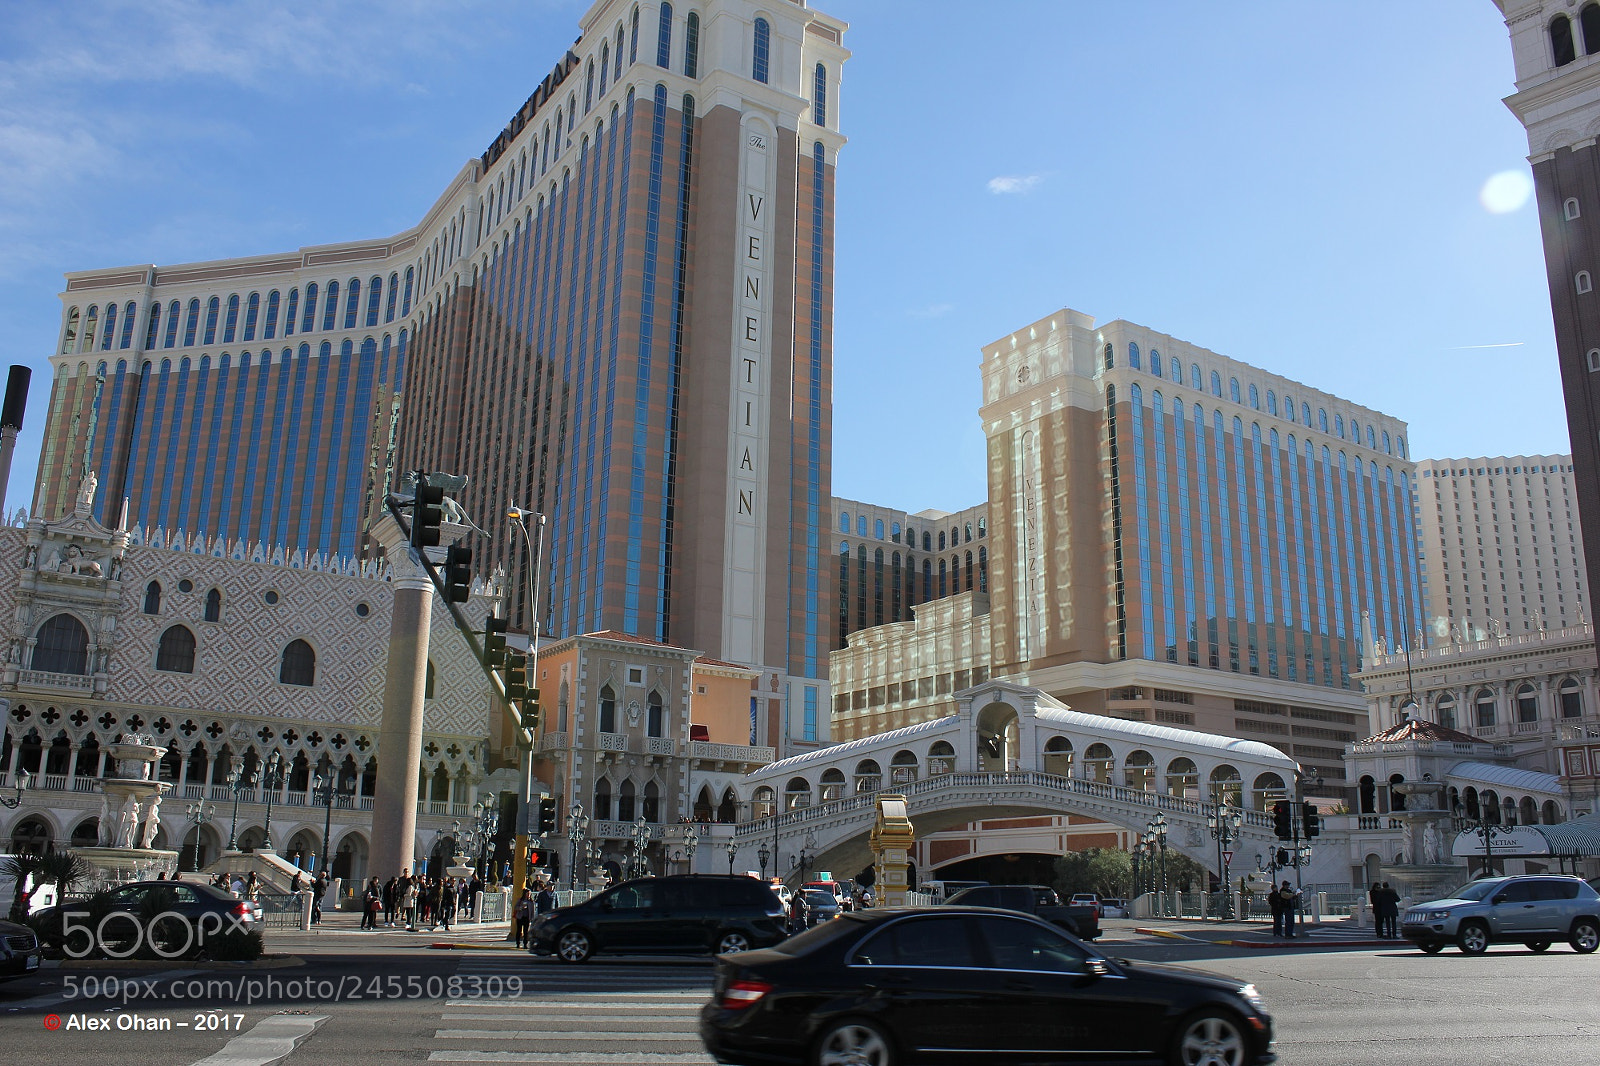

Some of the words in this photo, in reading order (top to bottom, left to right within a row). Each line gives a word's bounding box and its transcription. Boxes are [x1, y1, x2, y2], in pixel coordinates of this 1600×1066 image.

[749, 135, 766, 150] The
[738, 193, 763, 516] VENETIAN
[1026, 478, 1037, 611] VENEZIA
[1480, 839, 1517, 847] VNETIAN
